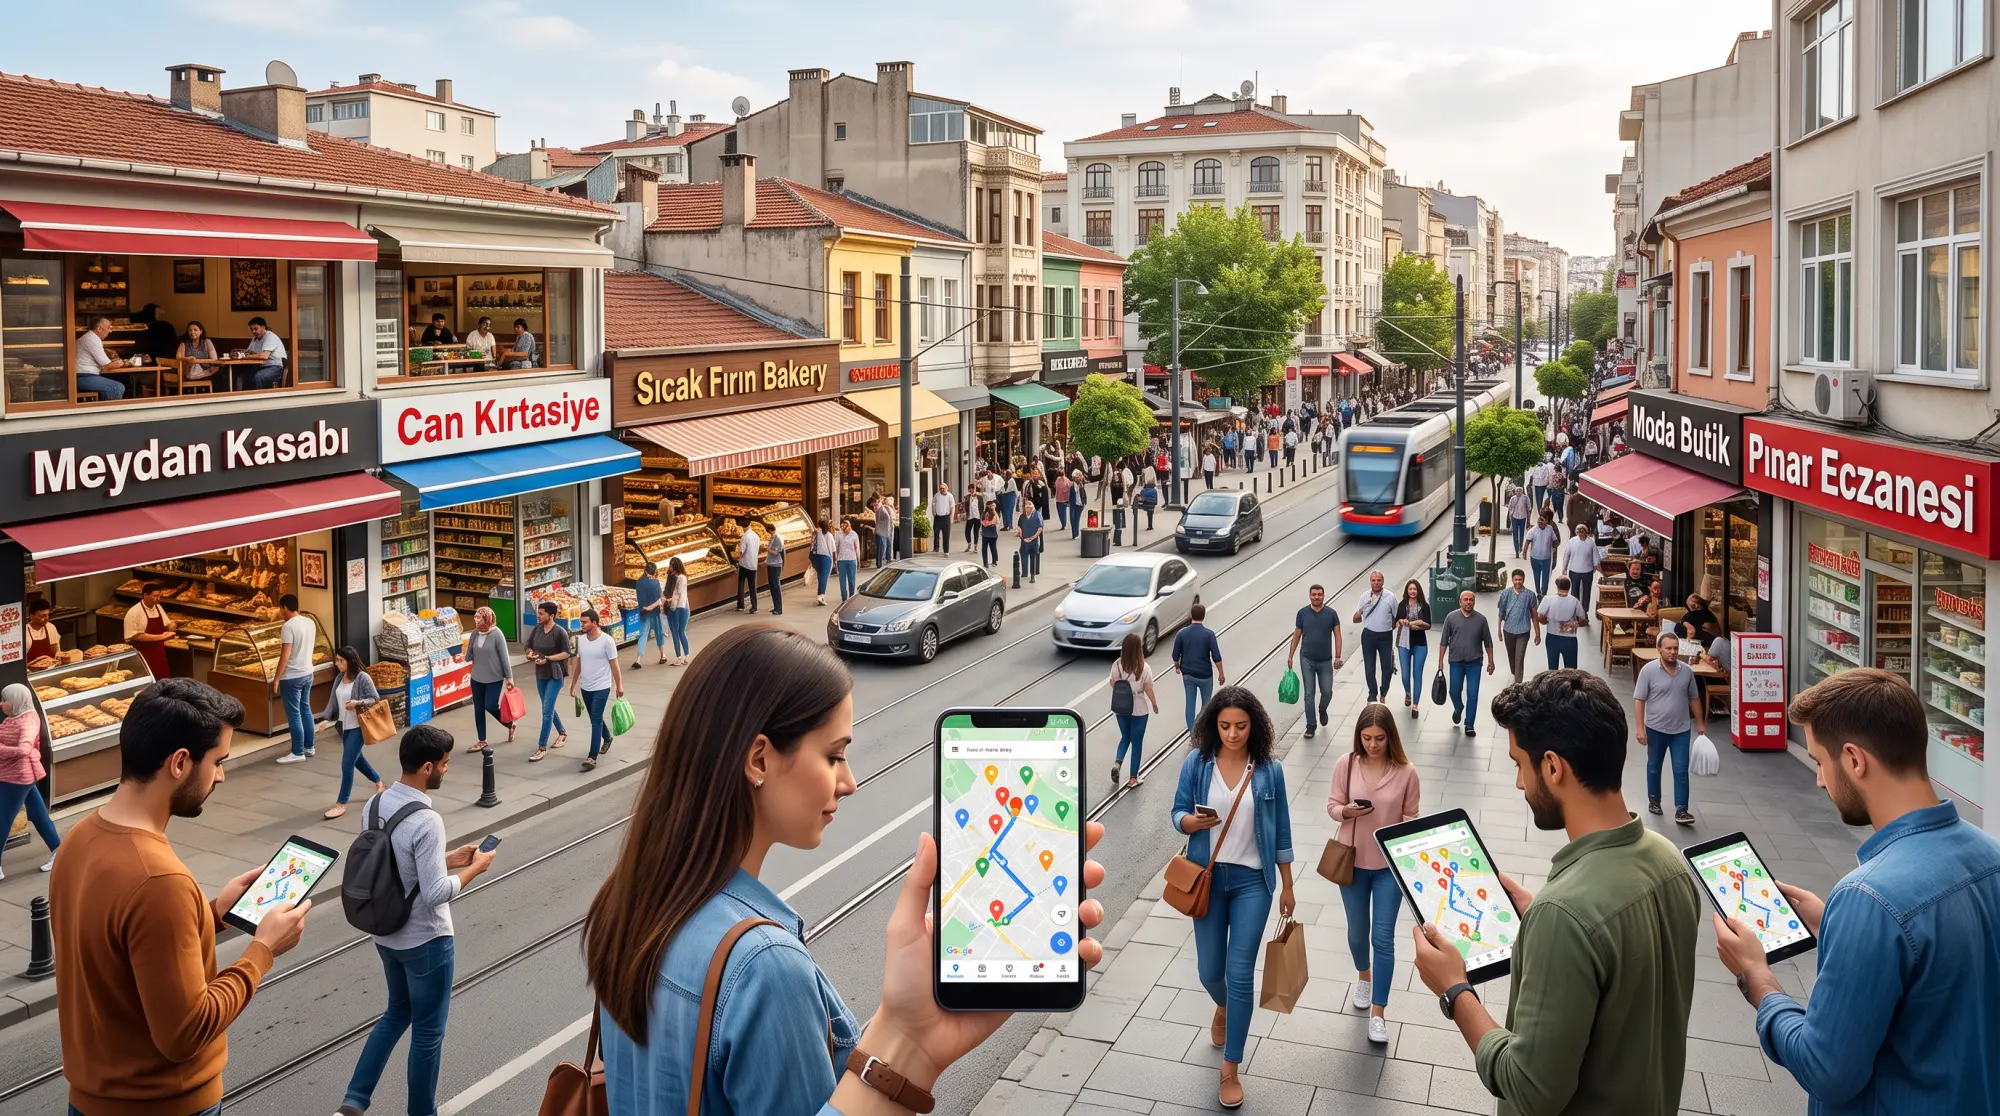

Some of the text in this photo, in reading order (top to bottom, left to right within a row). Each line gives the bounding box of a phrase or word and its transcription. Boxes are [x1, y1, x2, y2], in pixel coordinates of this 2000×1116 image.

[637, 368, 703, 406] Sıcak
[709, 365, 757, 398] Fırın
[763, 359, 828, 392] Bakery
[397, 391, 600, 446] Can Kırtasiye
[1632, 404, 1731, 467] Moda Butik
[32, 419, 349, 497] Meydan Kasabı
[1749, 432, 1975, 534] Pınar Eczanesi
